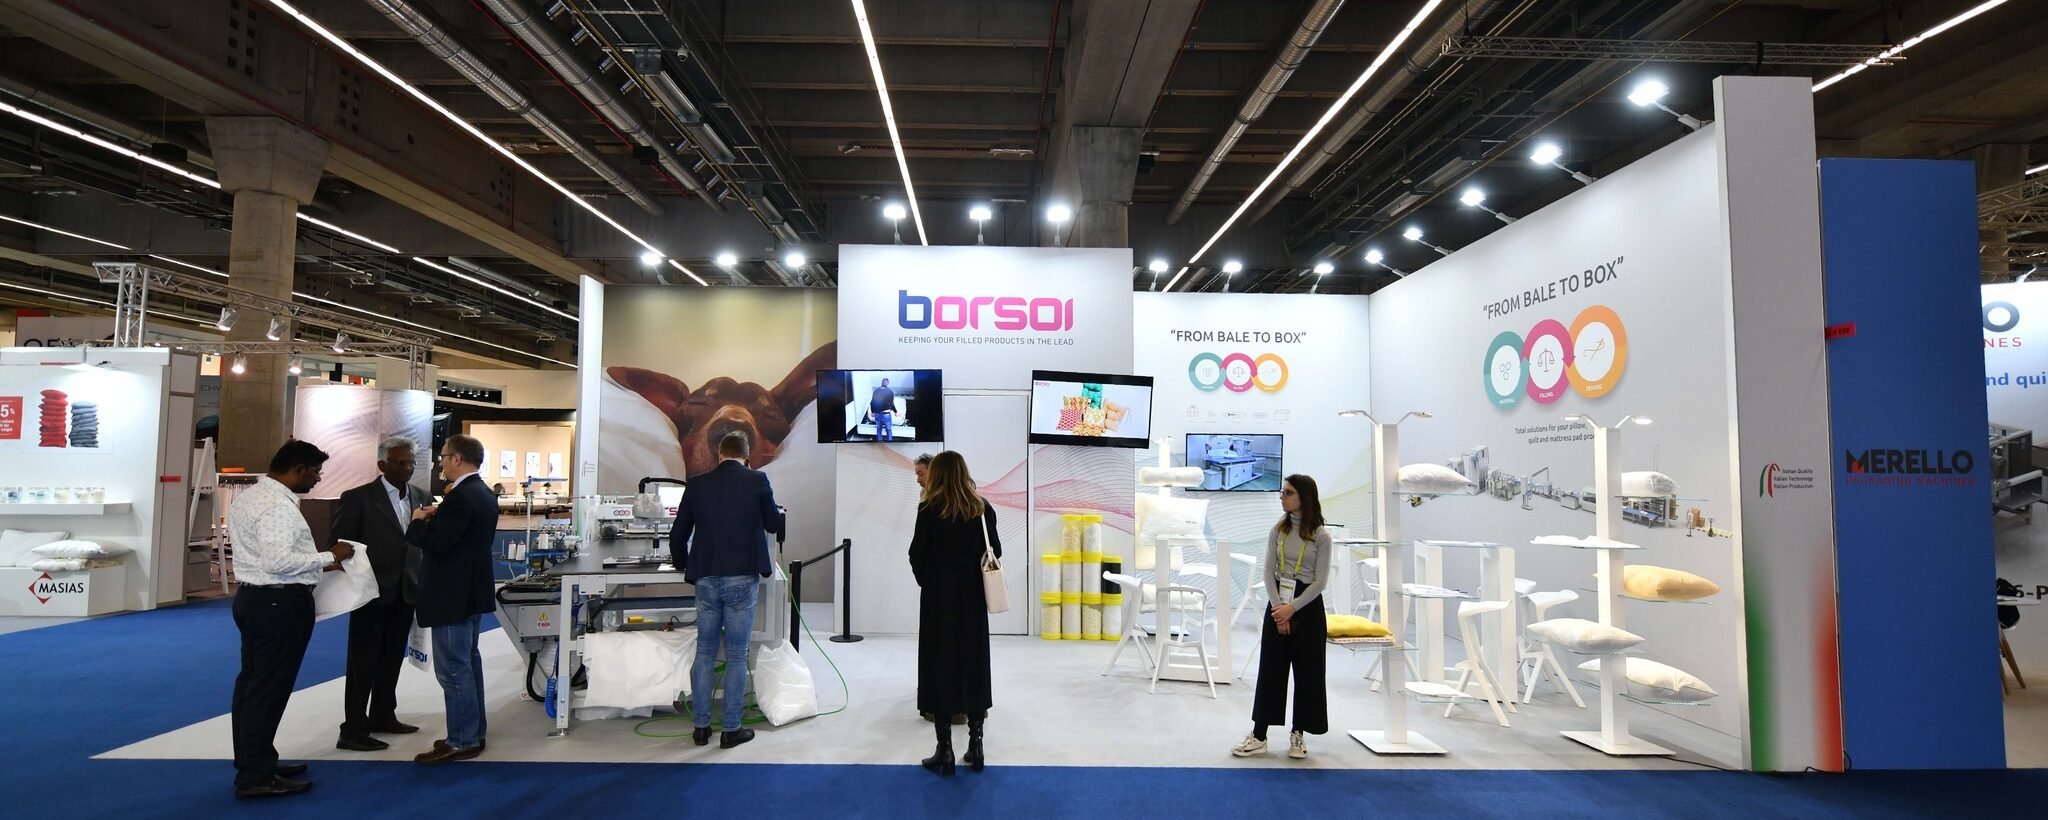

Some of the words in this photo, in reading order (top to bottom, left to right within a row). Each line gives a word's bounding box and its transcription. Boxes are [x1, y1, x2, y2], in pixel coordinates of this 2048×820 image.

[1523, 282, 1557, 307] BALE
[1559, 274, 1579, 295] TO
[899, 290, 1073, 331] borsoi
[899, 336, 932, 344] KEEPING
[934, 336, 954, 344] YOUR
[985, 337, 1025, 345] PRODUCTS
[1054, 338, 1073, 346] LEAD
[1218, 331, 1250, 342] BALE
[1253, 332, 1271, 343] TO
[1515, 427, 1526, 435] Total
[1527, 425, 1548, 434] solutions
[1548, 424, 1556, 432] for
[1557, 424, 1569, 432] your
[1569, 422, 1588, 431] pillow,
[1528, 436, 1539, 444] quilt
[1549, 434, 1572, 442] mattress
[1573, 433, 1583, 441] pad
[1846, 449, 1973, 474] MERELLO
[39, 582, 84, 593] MASIAS
